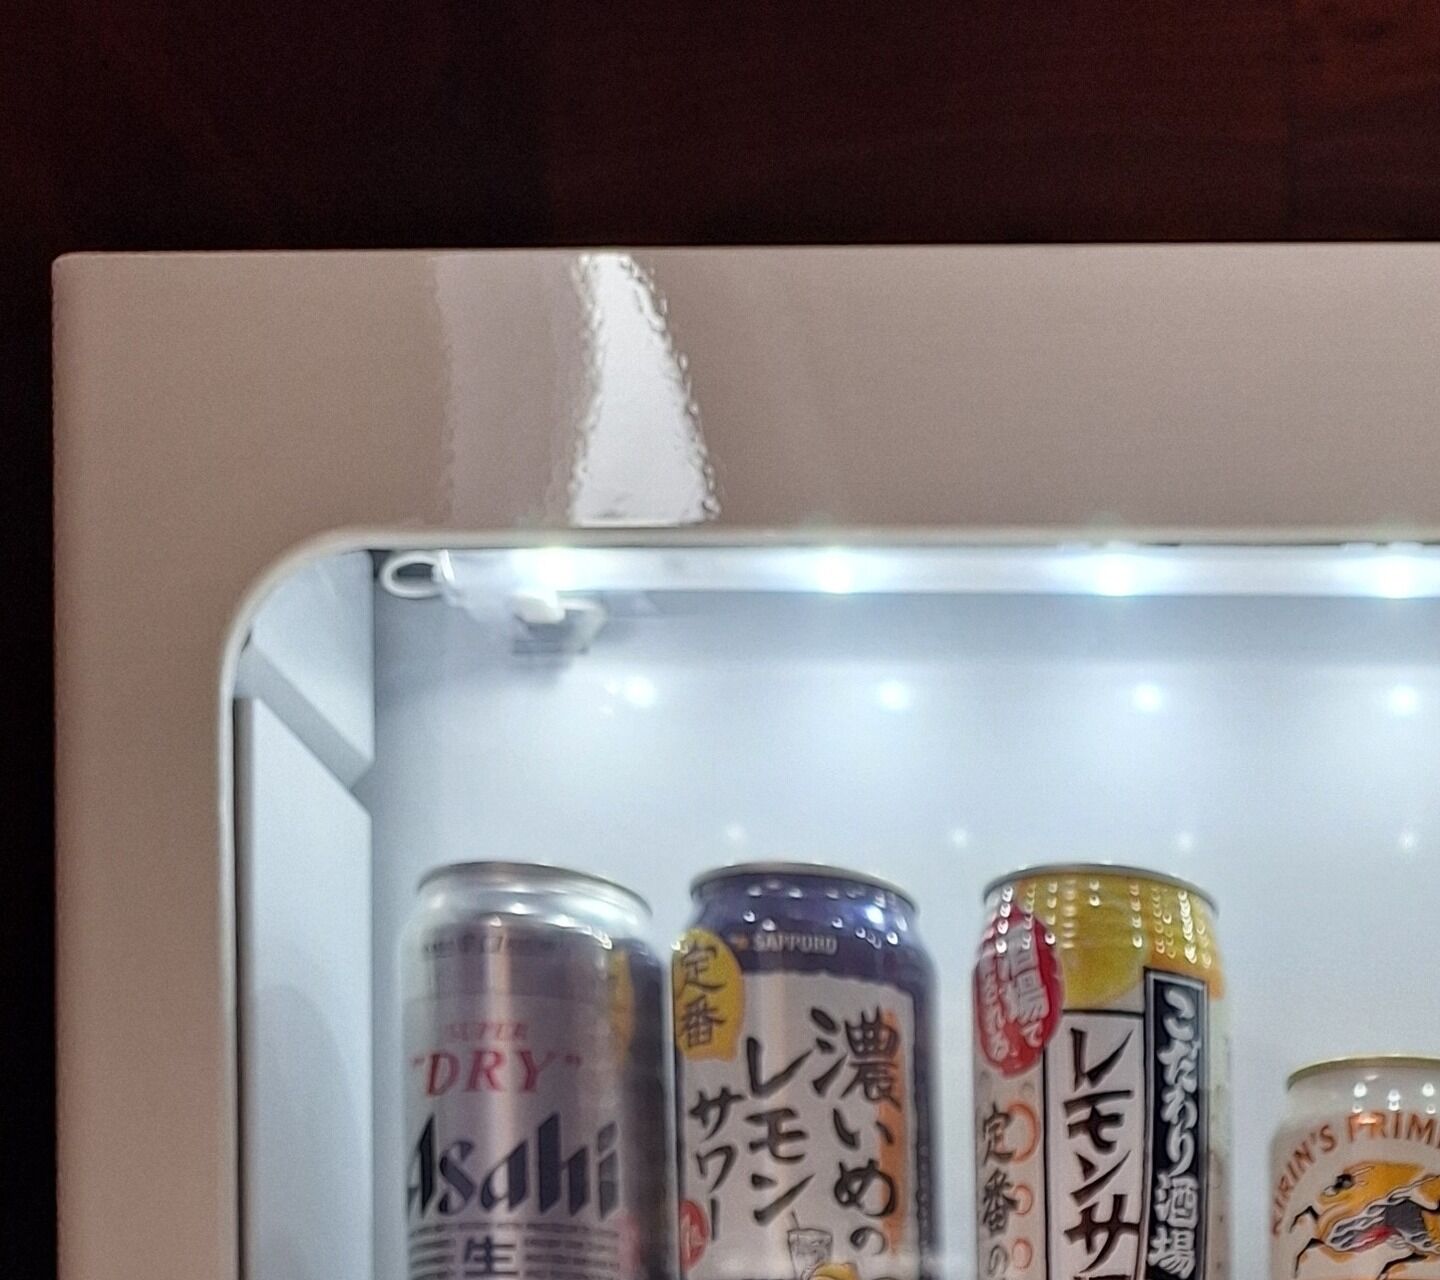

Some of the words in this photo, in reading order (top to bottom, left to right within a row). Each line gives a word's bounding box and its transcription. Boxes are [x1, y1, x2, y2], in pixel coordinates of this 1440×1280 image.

[677, 944, 722, 1048] 定番
[403, 1112, 619, 1220] Asahi
[690, 1086, 746, 1242] サワー
[745, 1036, 818, 1226] レモン
[806, 1005, 902, 1255] 濃いめの
[463, 1235, 519, 1278] 生
